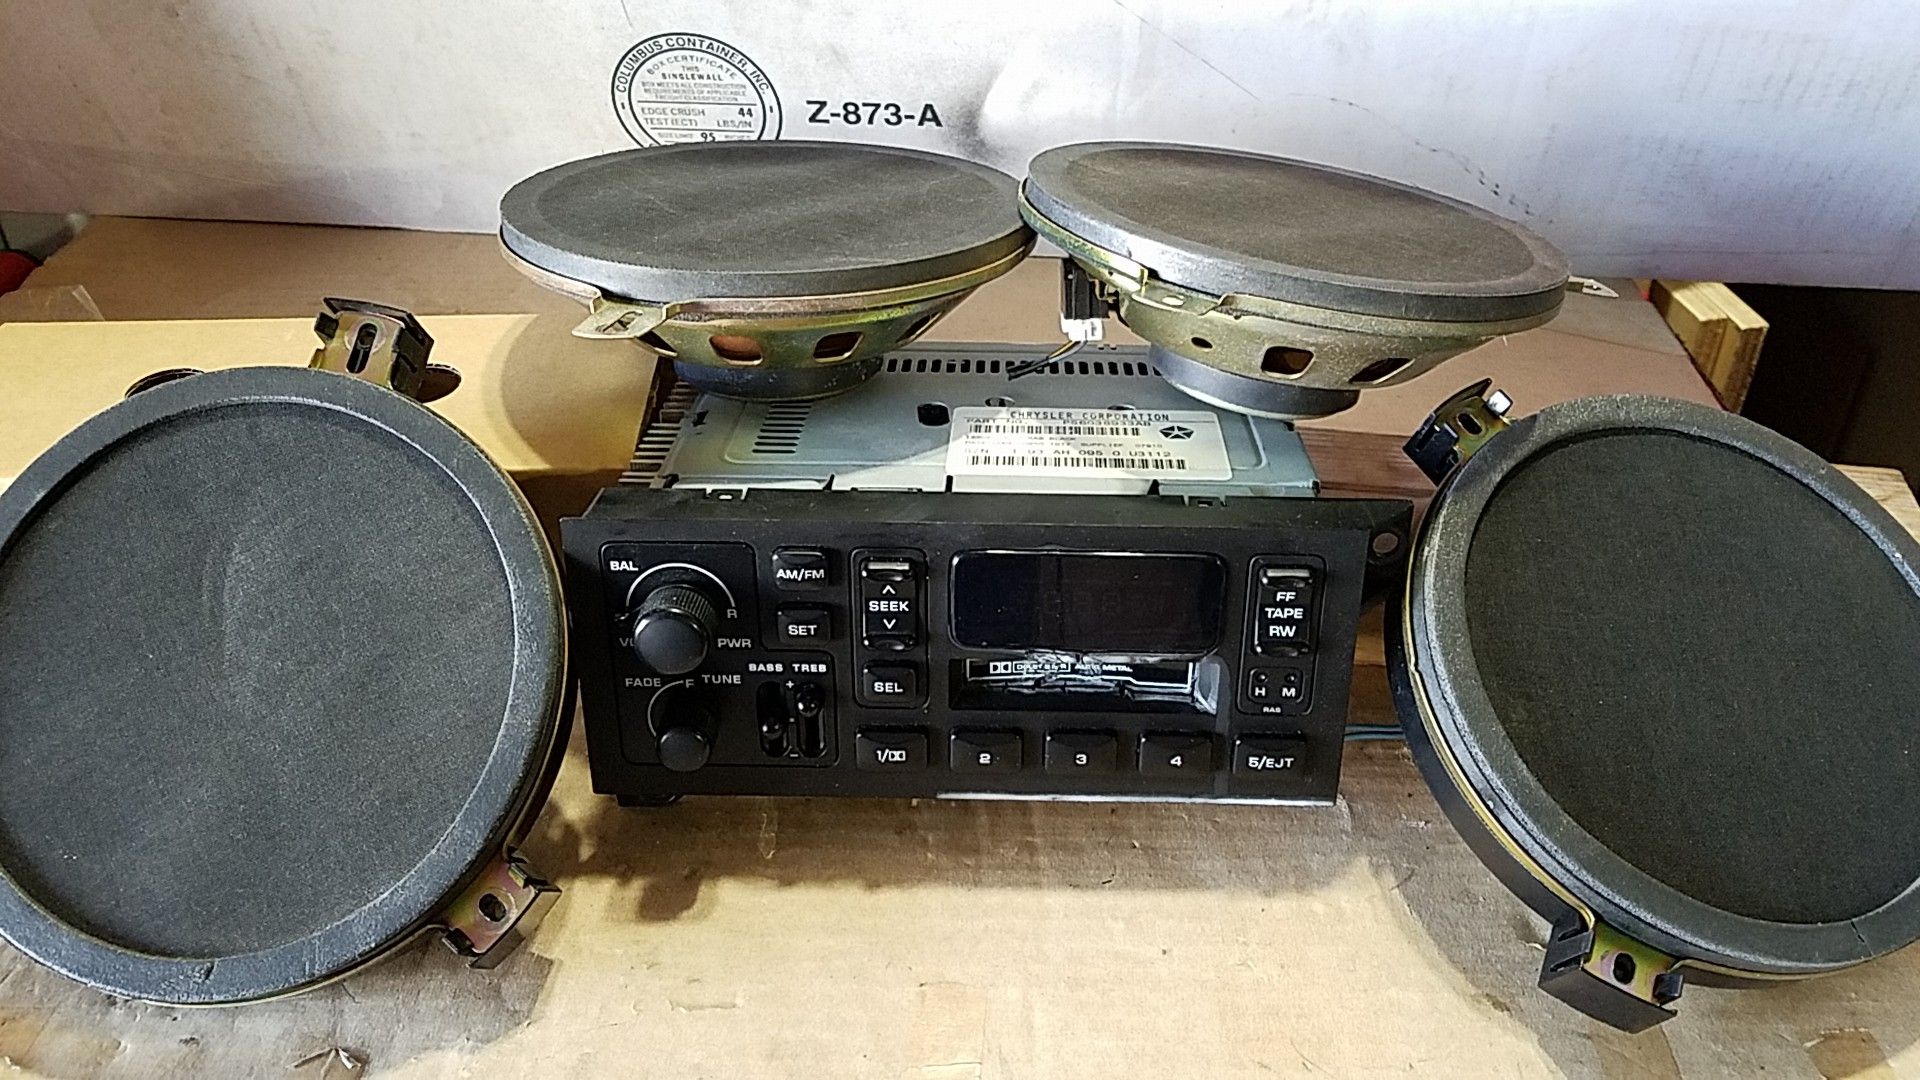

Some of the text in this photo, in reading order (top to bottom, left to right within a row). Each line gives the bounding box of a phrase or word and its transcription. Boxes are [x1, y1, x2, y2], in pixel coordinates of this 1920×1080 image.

[616, 37, 769, 95] COLUMBUS CONTAINER, INC.
[646, 55, 737, 80] BOX CERTIFICATE
[661, 73, 723, 81] SINGLEWALL
[641, 107, 705, 116] EDGE CRUSH
[738, 107, 754, 118] 44
[806, 101, 943, 128] Z-873-A
[644, 118, 698, 127] TEST (ECT)
[717, 120, 752, 128] LBS/IN
[701, 132, 716, 142] 95
[1010, 411, 1169, 421] CHRYSLER CORPORATION
[610, 561, 638, 571] BAL
[776, 569, 825, 581] AM/FM
[1276, 592, 1296, 601] FF
[869, 600, 909, 612] SEEK
[727, 609, 737, 619] R
[1265, 608, 1303, 619] TAPE
[788, 625, 817, 635] SET
[1269, 626, 1296, 637] RW
[717, 639, 751, 648] PWR
[749, 663, 827, 672] BASS TREB
[625, 678, 661, 687] FADE
[685, 679, 694, 688] F
[702, 674, 741, 684] TUNE
[874, 682, 903, 693] SEL
[1255, 687, 1265, 696] H
[1282, 688, 1296, 697] M
[979, 754, 991, 764] 2
[1075, 754, 1087, 765] 3
[1170, 754, 1182, 765] 4
[1248, 756, 1295, 769] 5/EJT
